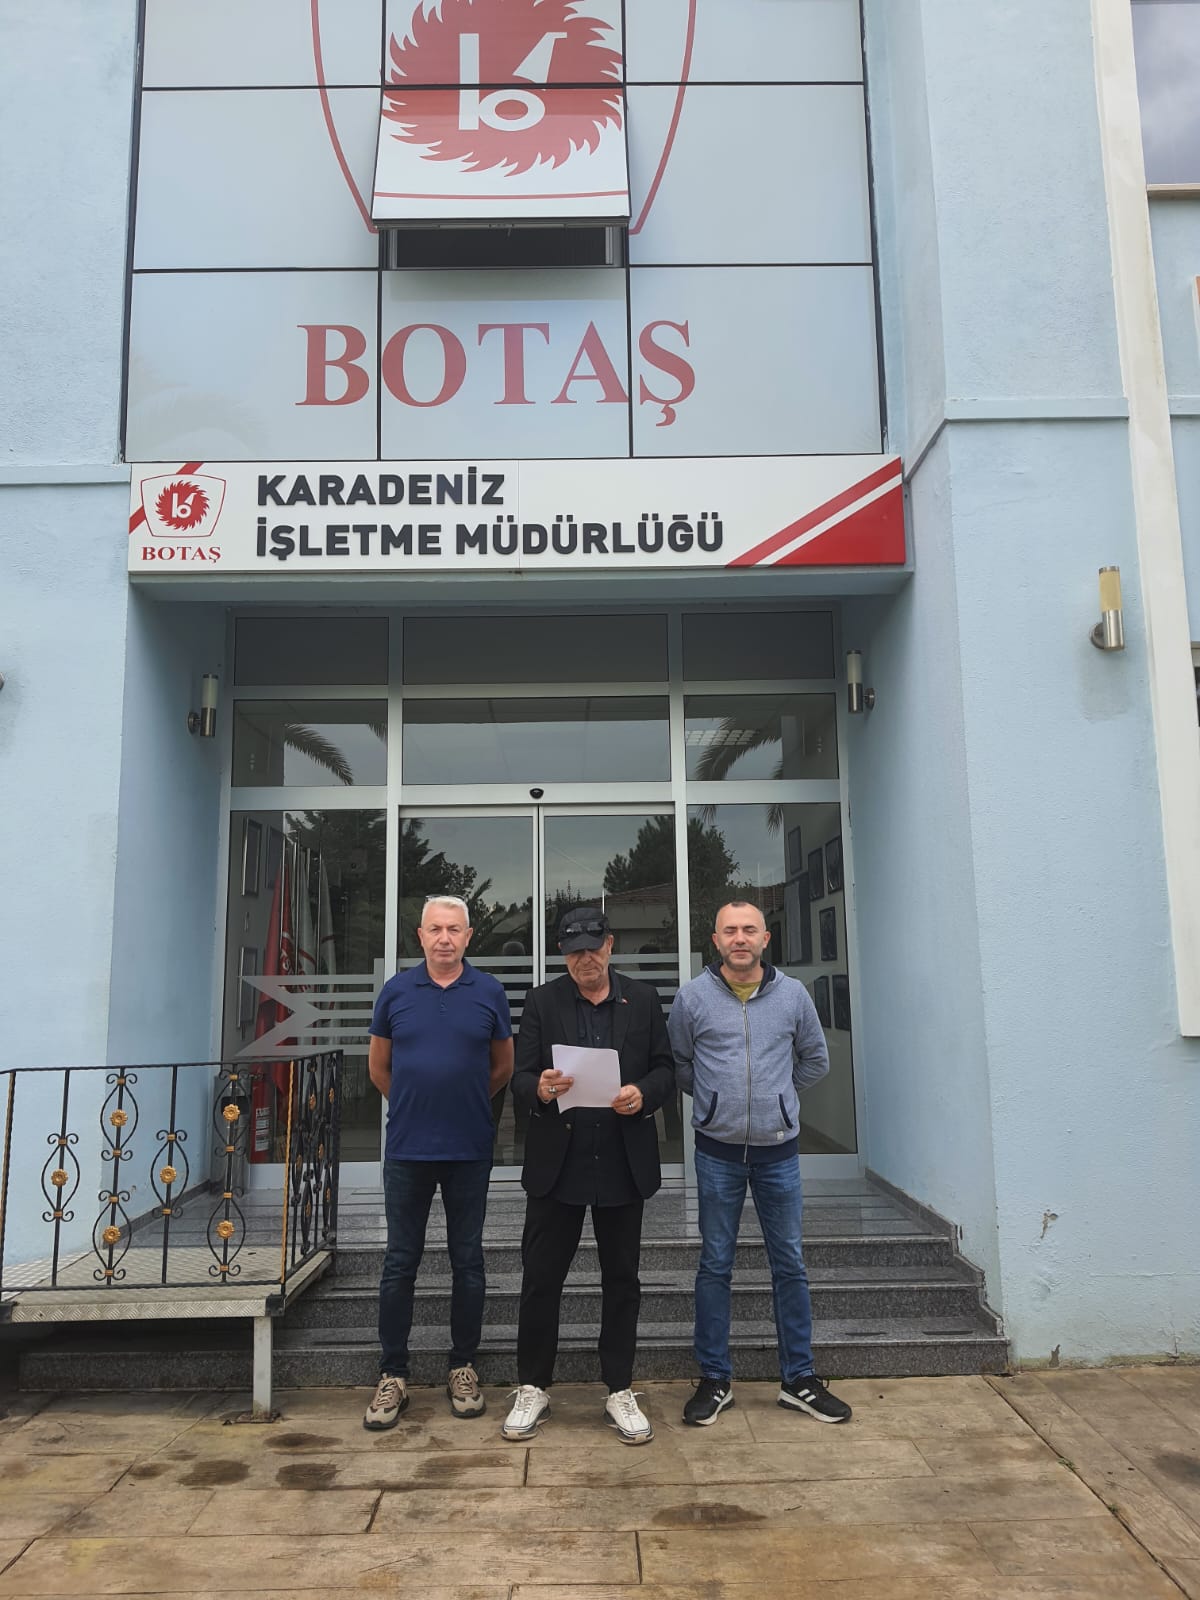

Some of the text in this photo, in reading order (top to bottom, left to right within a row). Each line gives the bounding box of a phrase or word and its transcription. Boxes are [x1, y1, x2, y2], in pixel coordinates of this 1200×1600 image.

[295, 319, 696, 427] BOTAŞ
[258, 466, 504, 506] KARADENİZ
[142, 546, 221, 563] BOTAŞ
[257, 517, 442, 561] İŞLETME
